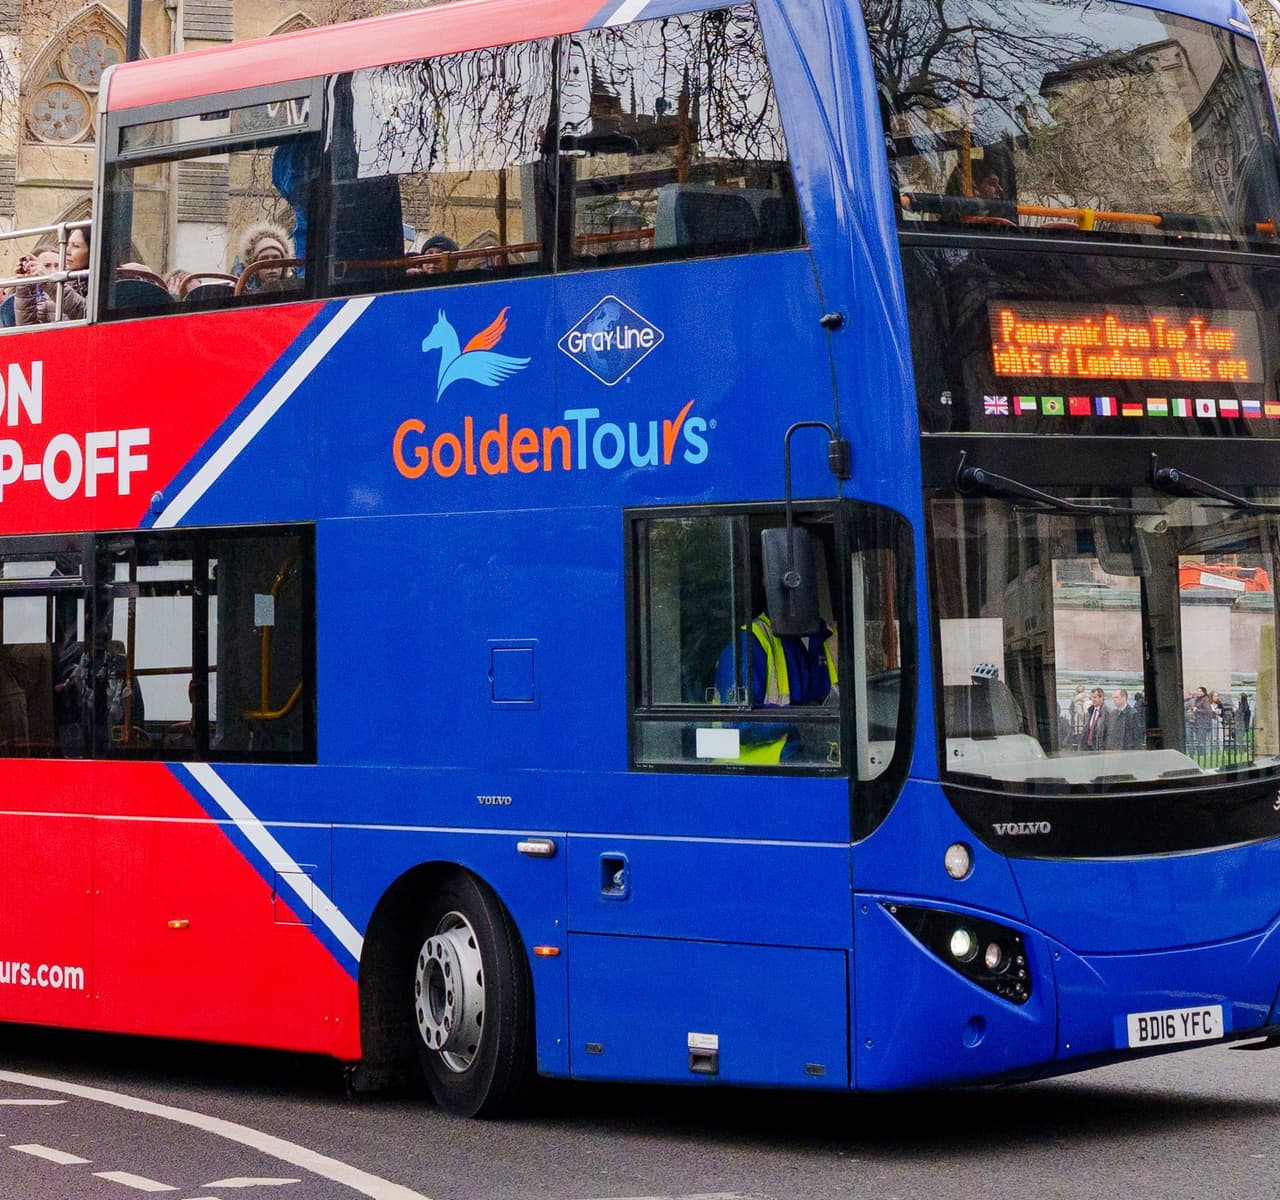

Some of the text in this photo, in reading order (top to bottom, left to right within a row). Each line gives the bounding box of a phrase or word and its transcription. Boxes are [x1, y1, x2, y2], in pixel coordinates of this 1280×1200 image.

[1000, 311, 1234, 350] Panoramic Open Top Tour
[1049, 347, 1069, 374] of
[1075, 348, 1144, 376] London
[1148, 357, 1171, 377] on
[1176, 352, 1212, 378] this
[476, 795, 513, 805] VOLVO
[992, 820, 1052, 836] VOLVO
[1138, 1010, 1212, 1042] BD16 YFC
